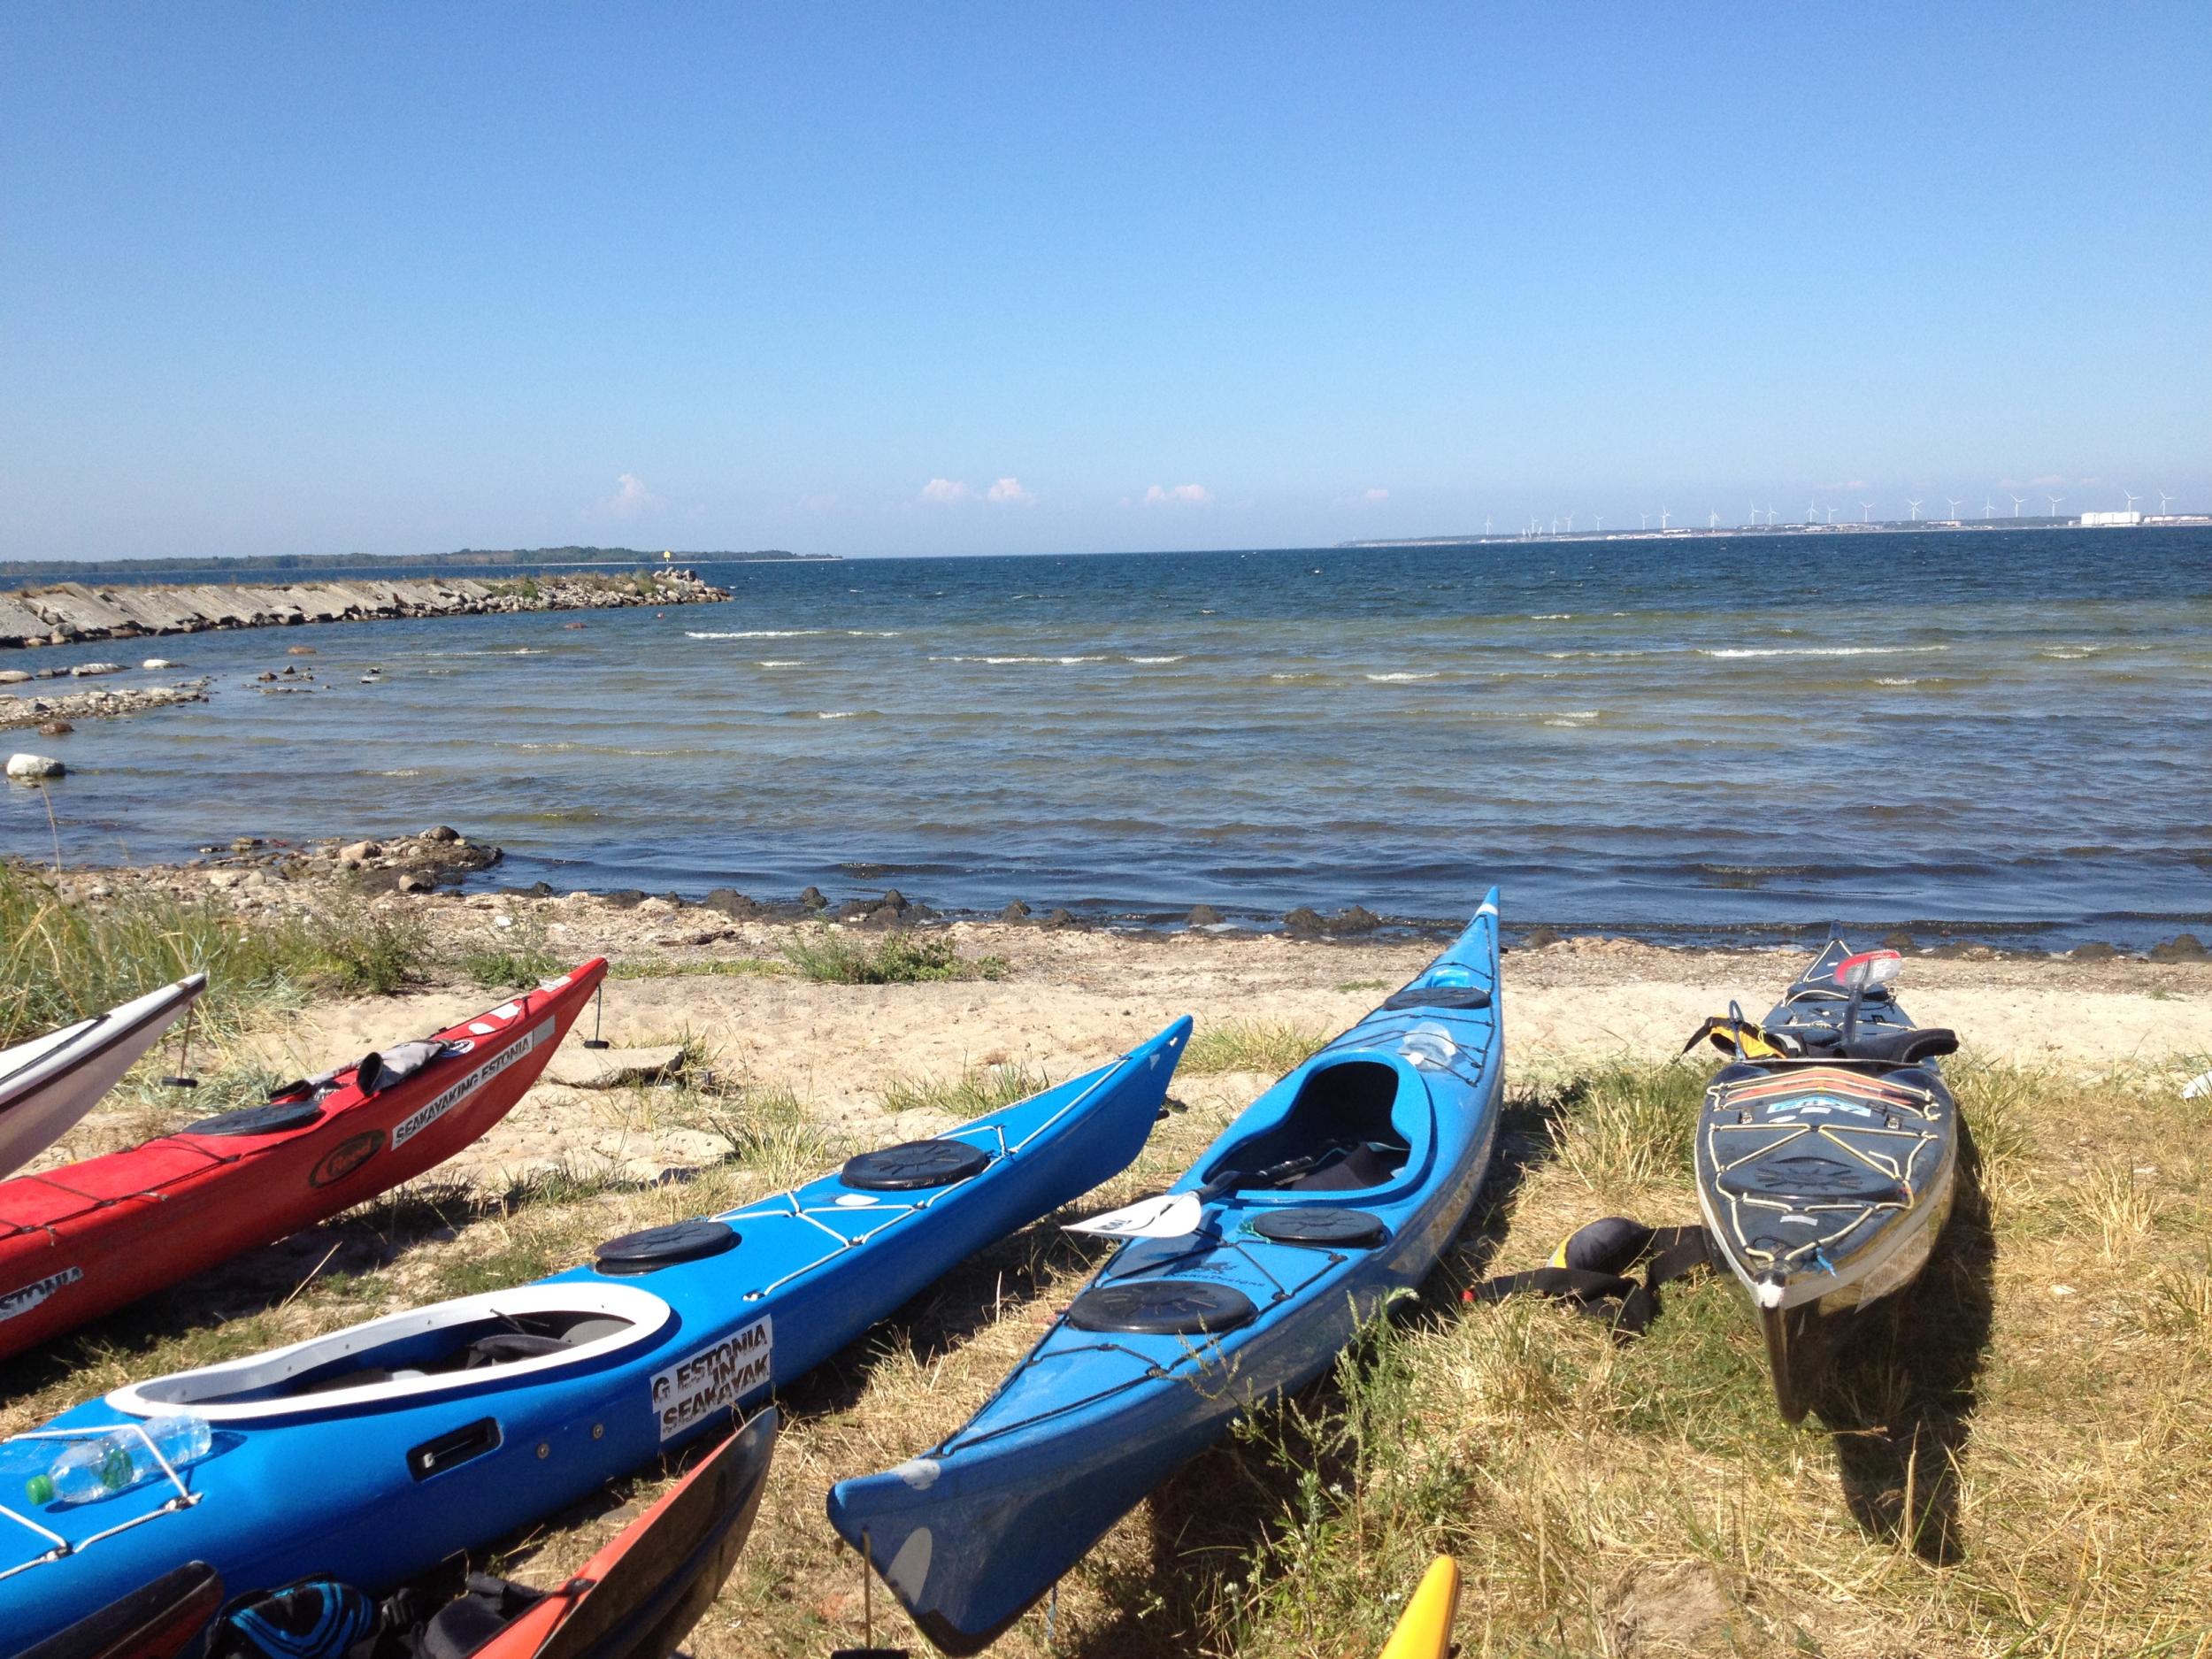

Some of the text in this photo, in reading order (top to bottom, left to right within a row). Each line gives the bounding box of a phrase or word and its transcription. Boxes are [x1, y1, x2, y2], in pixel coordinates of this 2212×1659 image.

[396, 1038, 530, 1144] SEAKAYAKING ESTONIA
[653, 1324, 768, 1403] G ESTONIA
[663, 1353, 770, 1434] SEAKAYAK
[712, 1355, 736, 1387] IN
